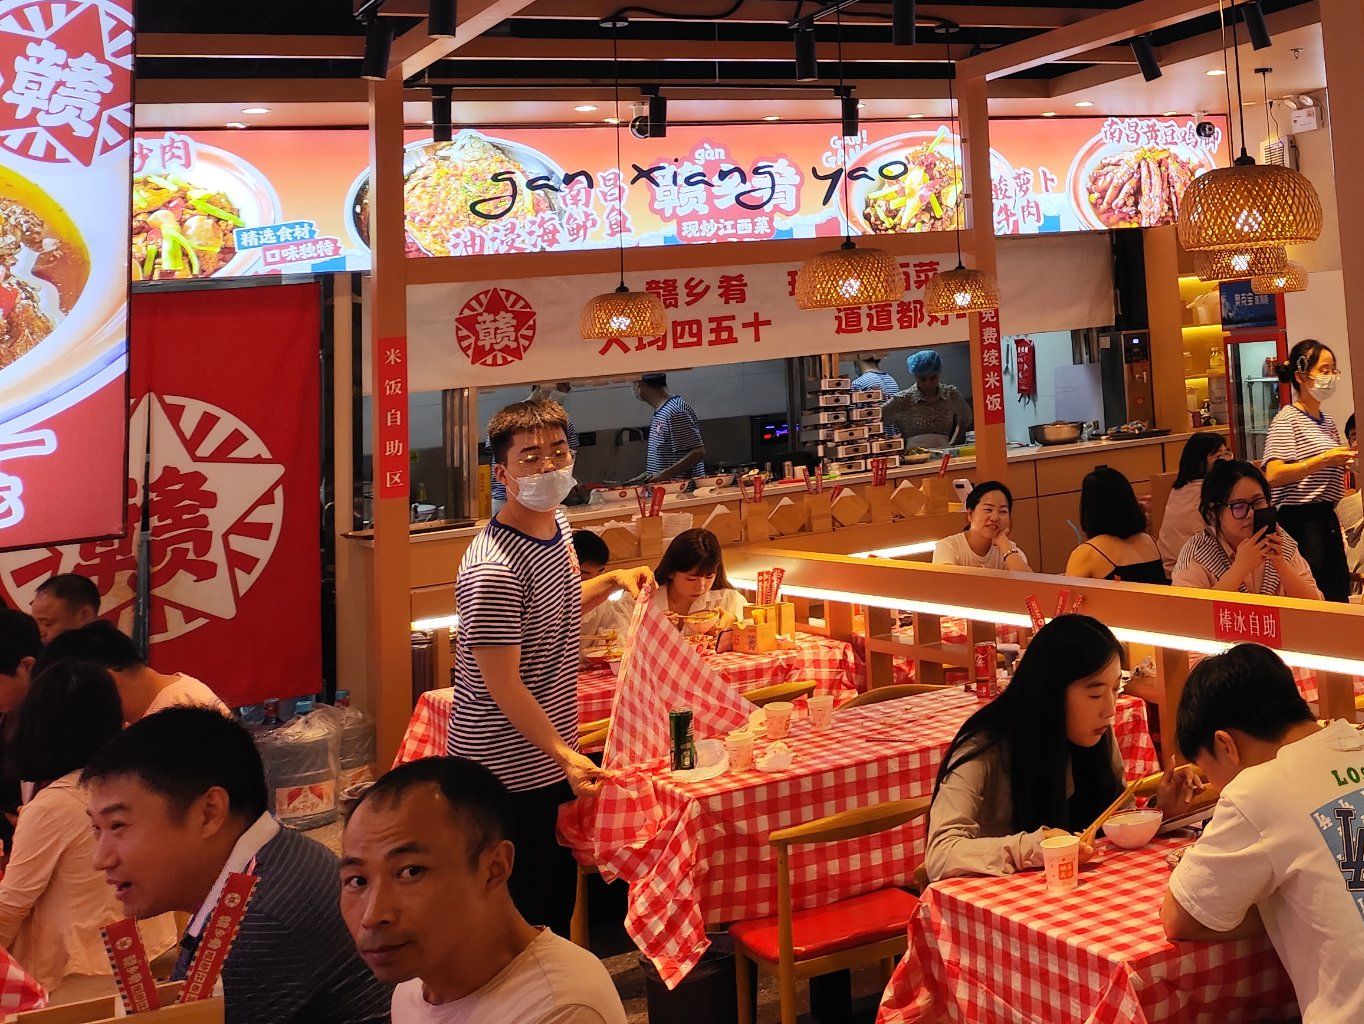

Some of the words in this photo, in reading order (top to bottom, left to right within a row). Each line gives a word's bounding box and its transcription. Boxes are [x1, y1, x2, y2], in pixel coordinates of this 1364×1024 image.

[2, 40, 113, 138] 赣
[470, 170, 594, 219] gan
[631, 157, 775, 209] xiang
[812, 160, 909, 206] yao
[240, 224, 313, 247] 精选食材
[681, 216, 771, 238] 现炒江西菜
[263, 240, 334, 263] 口味独特
[646, 273, 748, 310] 赣乡肴
[476, 309, 518, 349] 赣
[835, 299, 967, 335] 道道都
[981, 309, 1002, 412] 免费续米饭
[382, 347, 404, 489] 米饭自助区
[1218, 607, 1277, 638] 棒冰自助
